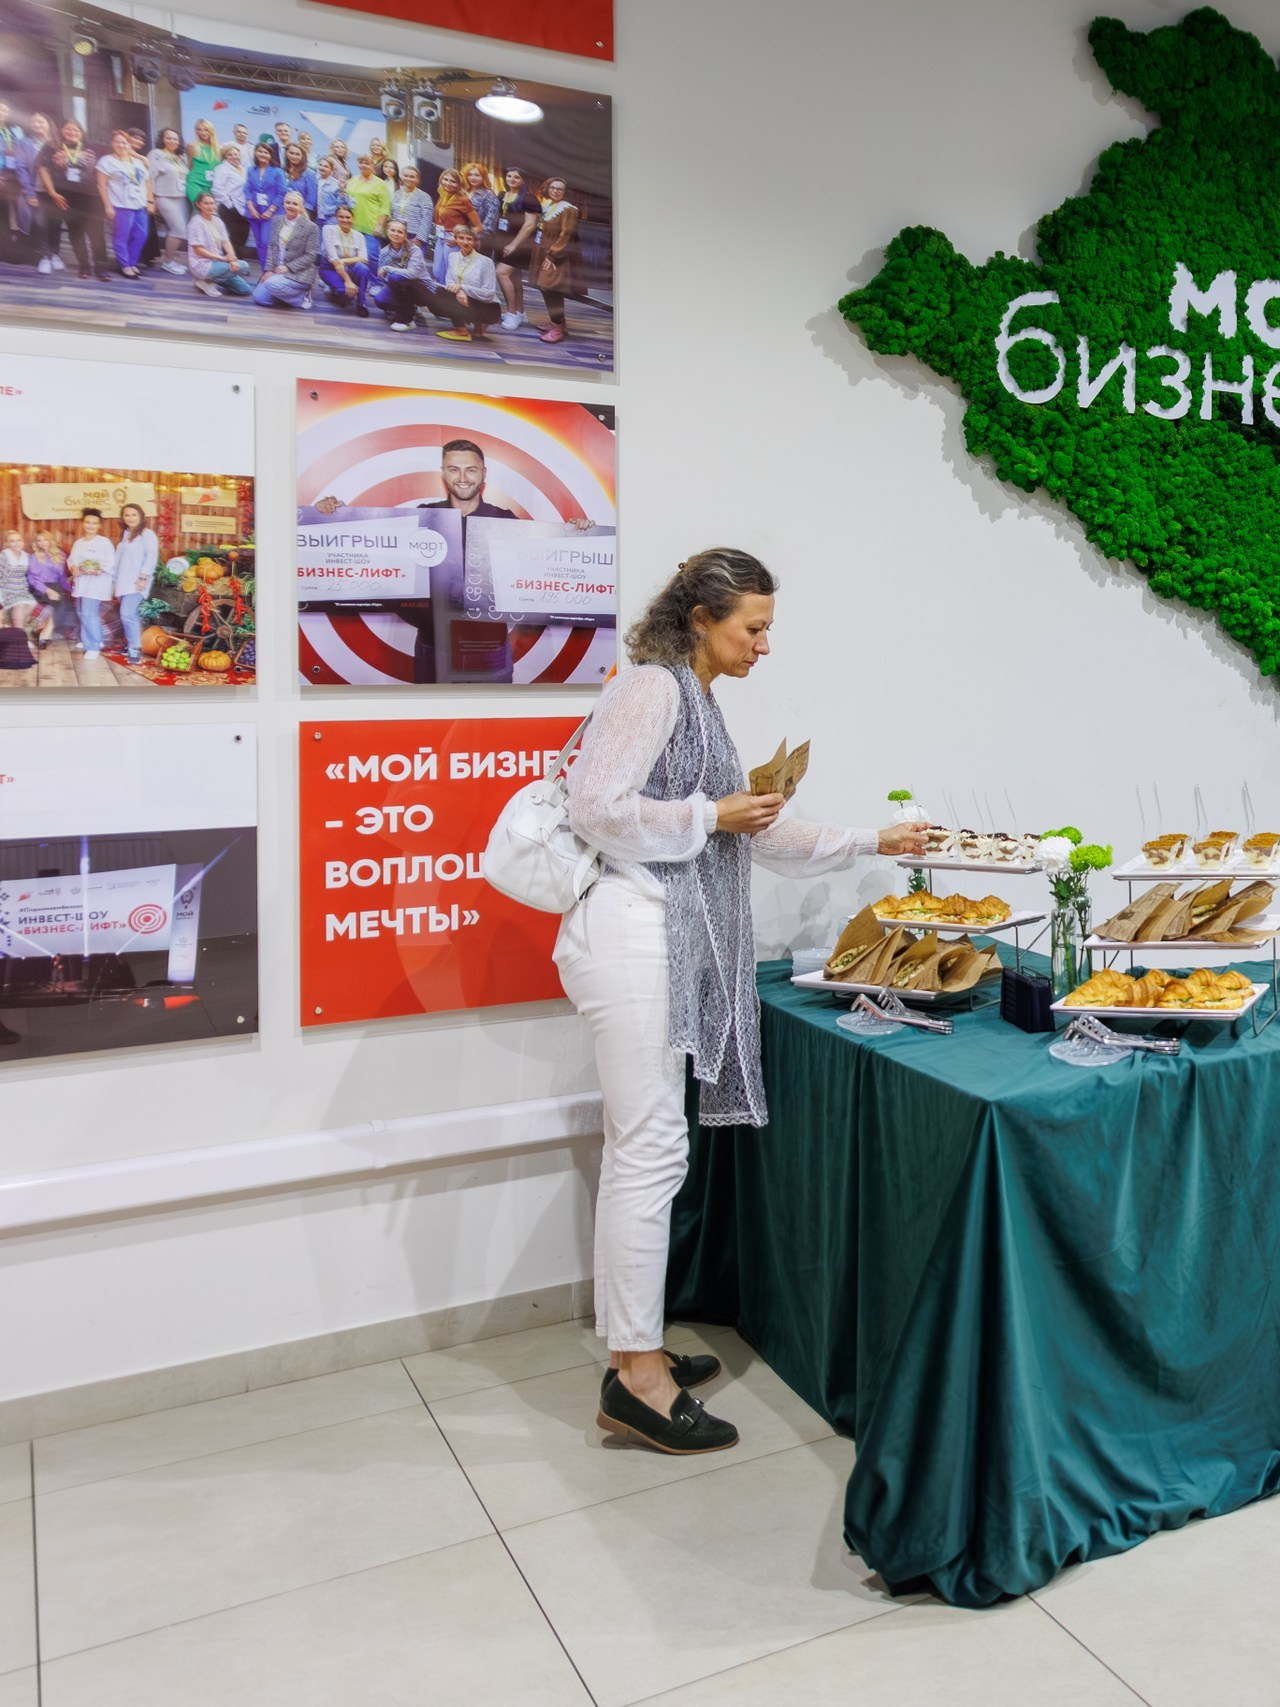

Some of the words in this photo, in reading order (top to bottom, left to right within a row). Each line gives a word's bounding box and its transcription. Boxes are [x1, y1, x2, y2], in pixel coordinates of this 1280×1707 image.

[325, 747, 437, 783] «МОЙ
[355, 804, 434, 835] ЭТО
[325, 904, 480, 942] МЕЧТЫ»
